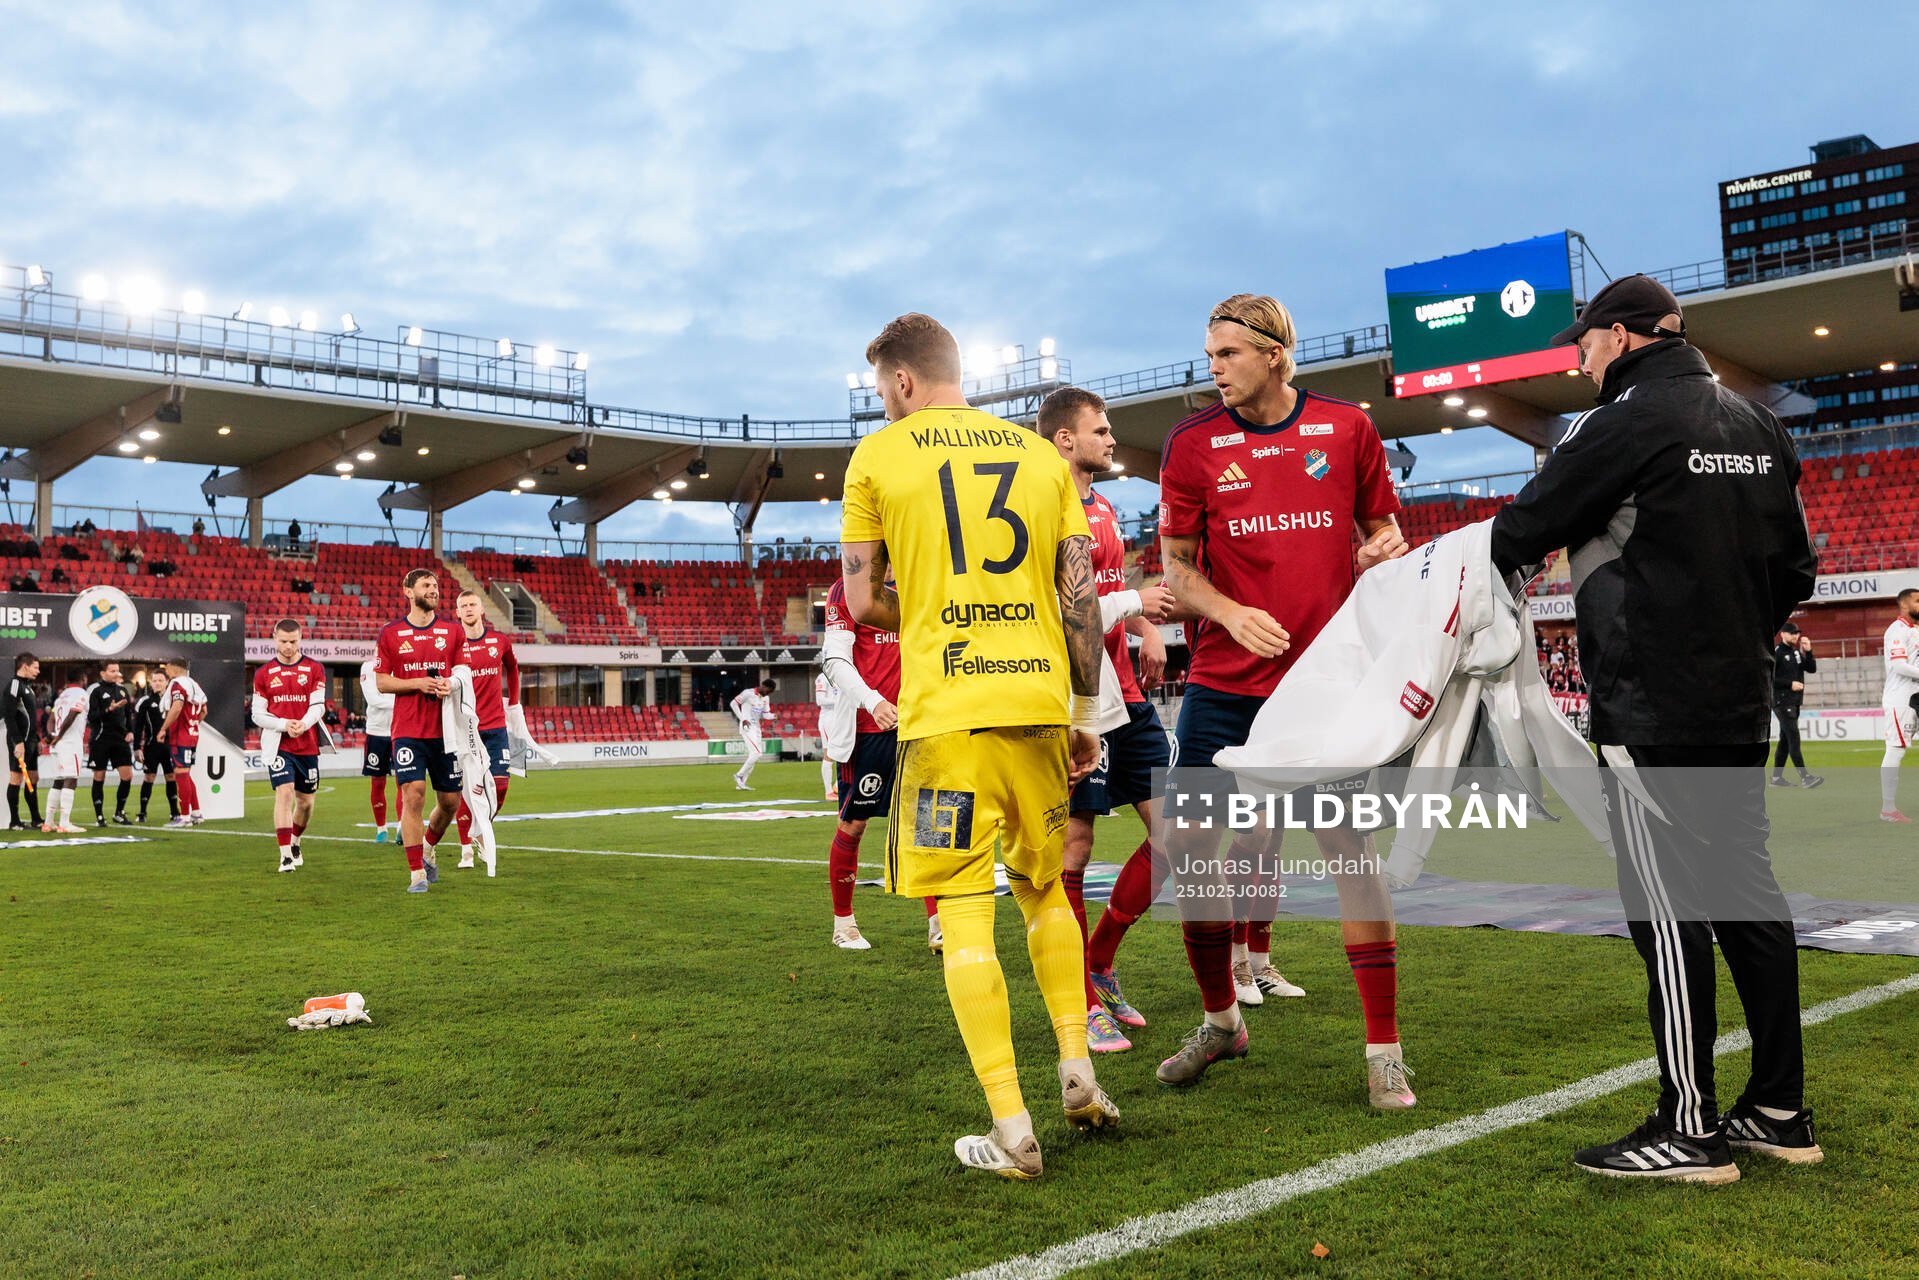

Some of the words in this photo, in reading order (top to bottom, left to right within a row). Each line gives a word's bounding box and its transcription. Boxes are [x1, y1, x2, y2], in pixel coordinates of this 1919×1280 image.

[911, 427, 1027, 450] WALLINDER
[1251, 445, 1280, 459] Spiris
[1688, 449, 1755, 474] ÖSTERS
[1757, 455, 1772, 474] IF
[1217, 481, 1252, 493] stadium
[938, 458, 1029, 576] 13
[1227, 510, 1334, 537] EMILSHUS
[1817, 579, 1878, 597] EMON
[0, 607, 53, 628] IBET
[153, 612, 232, 632] UNIBET
[941, 599, 1036, 629] dynacol
[874, 632, 900, 644] EMIL
[619, 651, 639, 660] Spiris
[949, 655, 1051, 677] Fellessons
[273, 694, 307, 703] EMILSHUS
[594, 745, 648, 757] PREMON
[207, 756, 226, 780] U
[1316, 780, 1365, 793] BALCO
